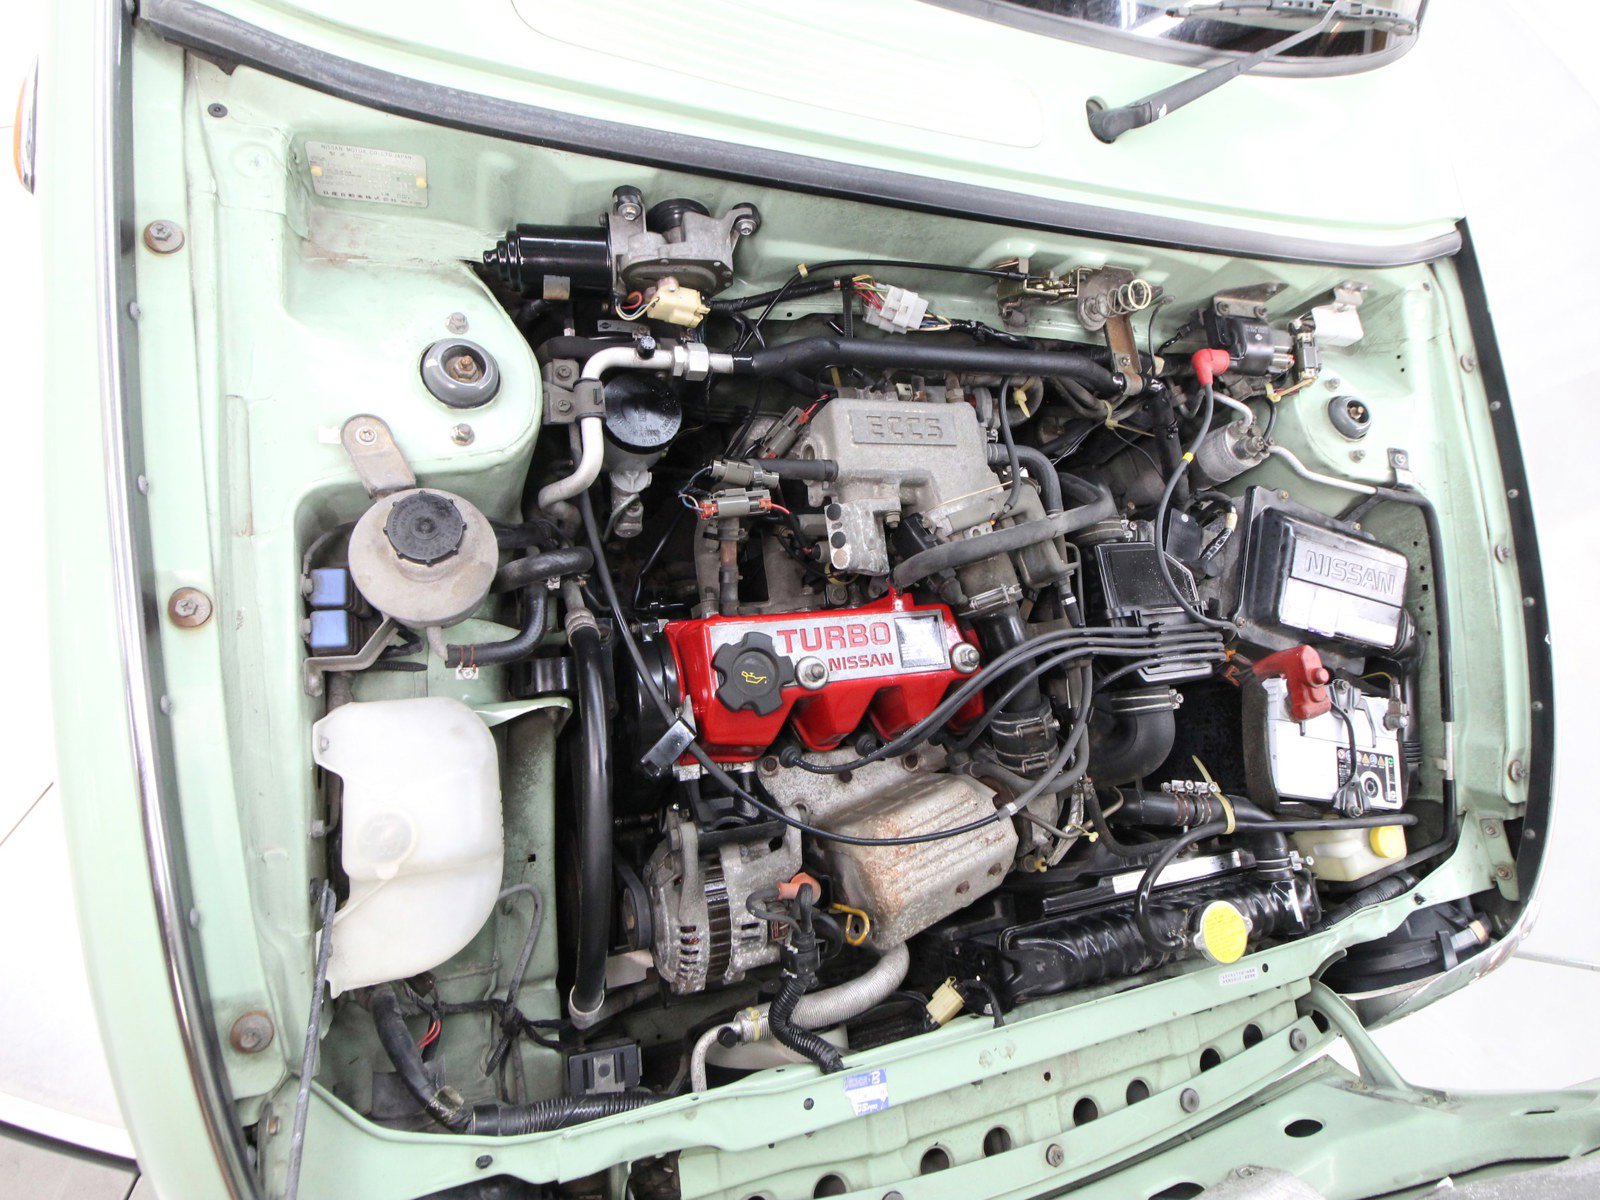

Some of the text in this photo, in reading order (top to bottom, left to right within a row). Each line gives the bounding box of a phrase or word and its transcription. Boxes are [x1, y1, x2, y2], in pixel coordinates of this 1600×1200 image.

[321, 144, 343, 152] NISSAN
[866, 415, 943, 438] ECCS
[1306, 550, 1396, 595] NISSAN
[776, 621, 891, 654] TURBO
[828, 652, 894, 672] NISSAN
